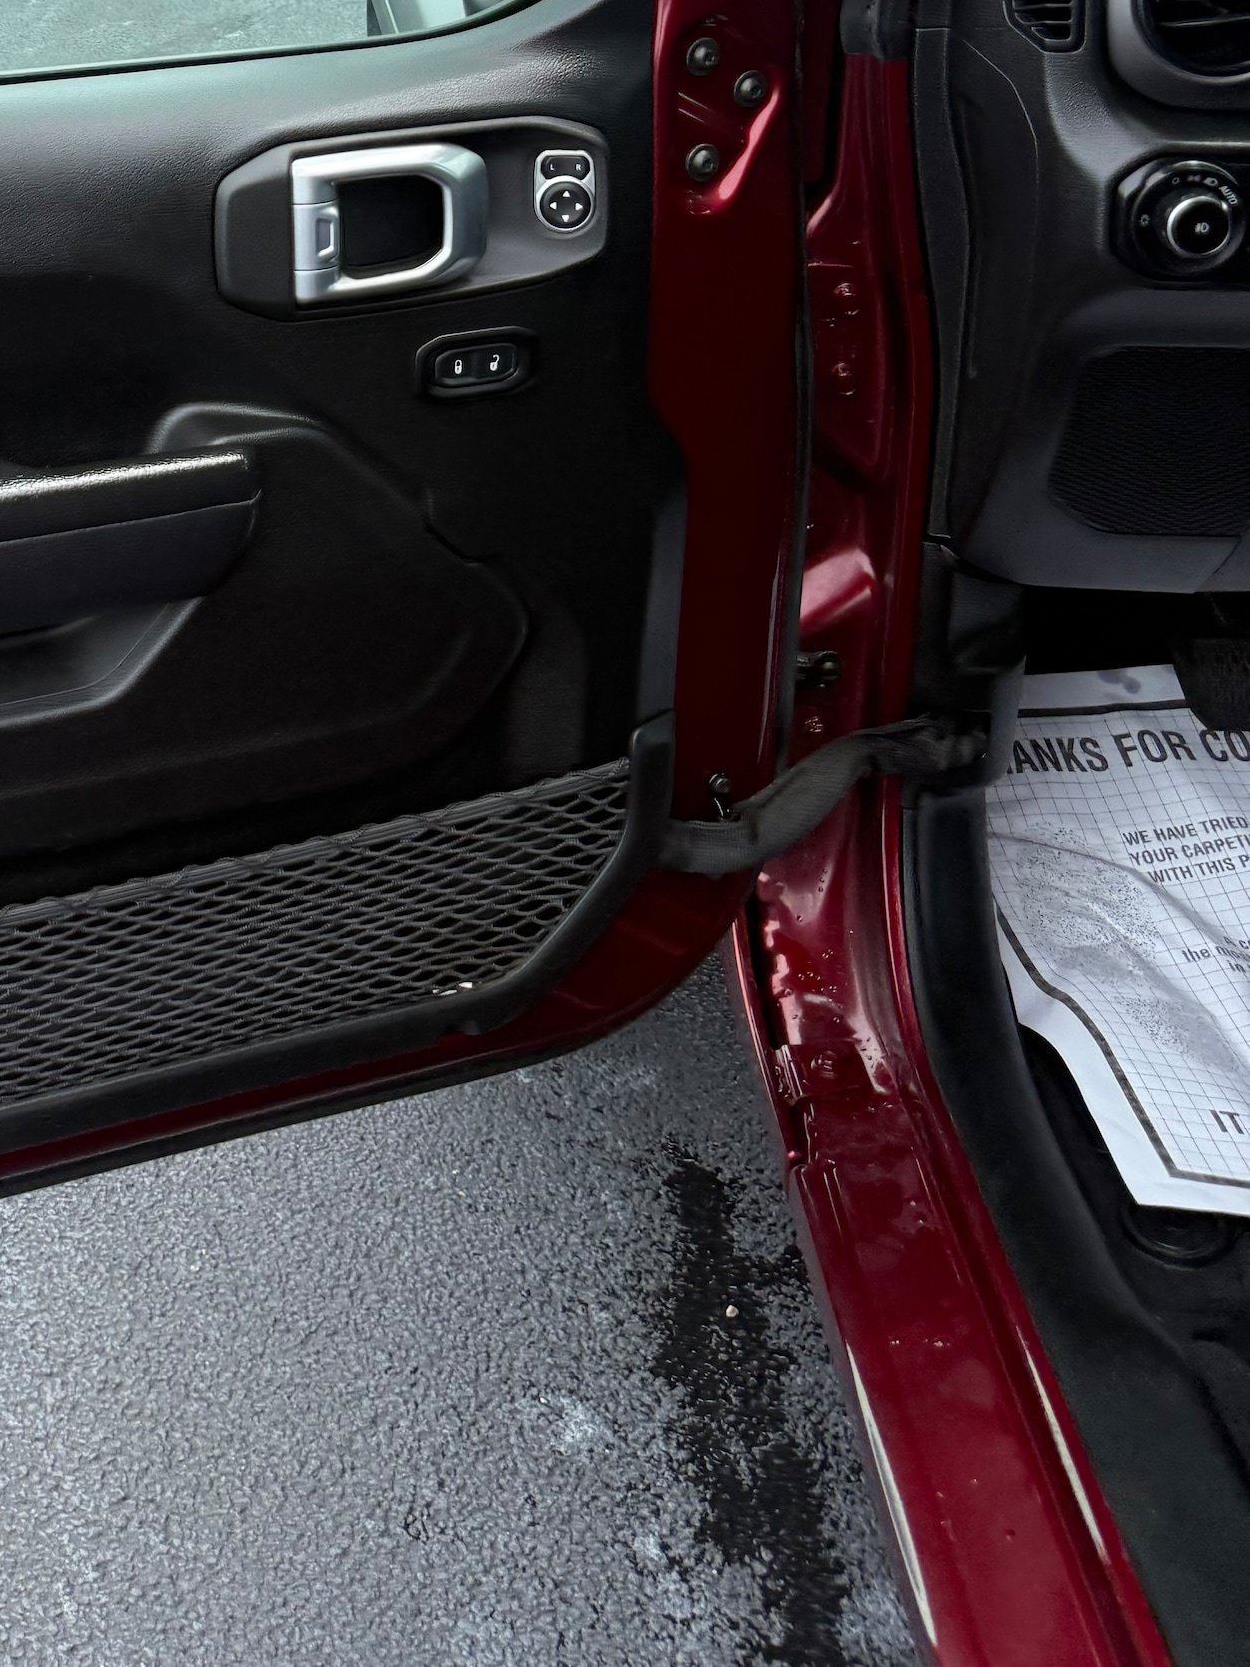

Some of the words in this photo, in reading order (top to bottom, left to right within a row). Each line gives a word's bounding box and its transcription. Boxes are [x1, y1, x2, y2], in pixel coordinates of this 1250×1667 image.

[1218, 186, 1238, 206] AUTO
[1007, 737, 1109, 774] ANKS
[1112, 730, 1197, 767] FOR
[1123, 830, 1152, 846] WE
[1153, 824, 1198, 842] HAVE
[1198, 816, 1249, 834] TRIED
[1129, 847, 1179, 866] YOUR
[1147, 865, 1193, 883] WITH
[1194, 857, 1236, 876] THIS
[1181, 948, 1211, 962] the
[1226, 959, 1246, 973] in
